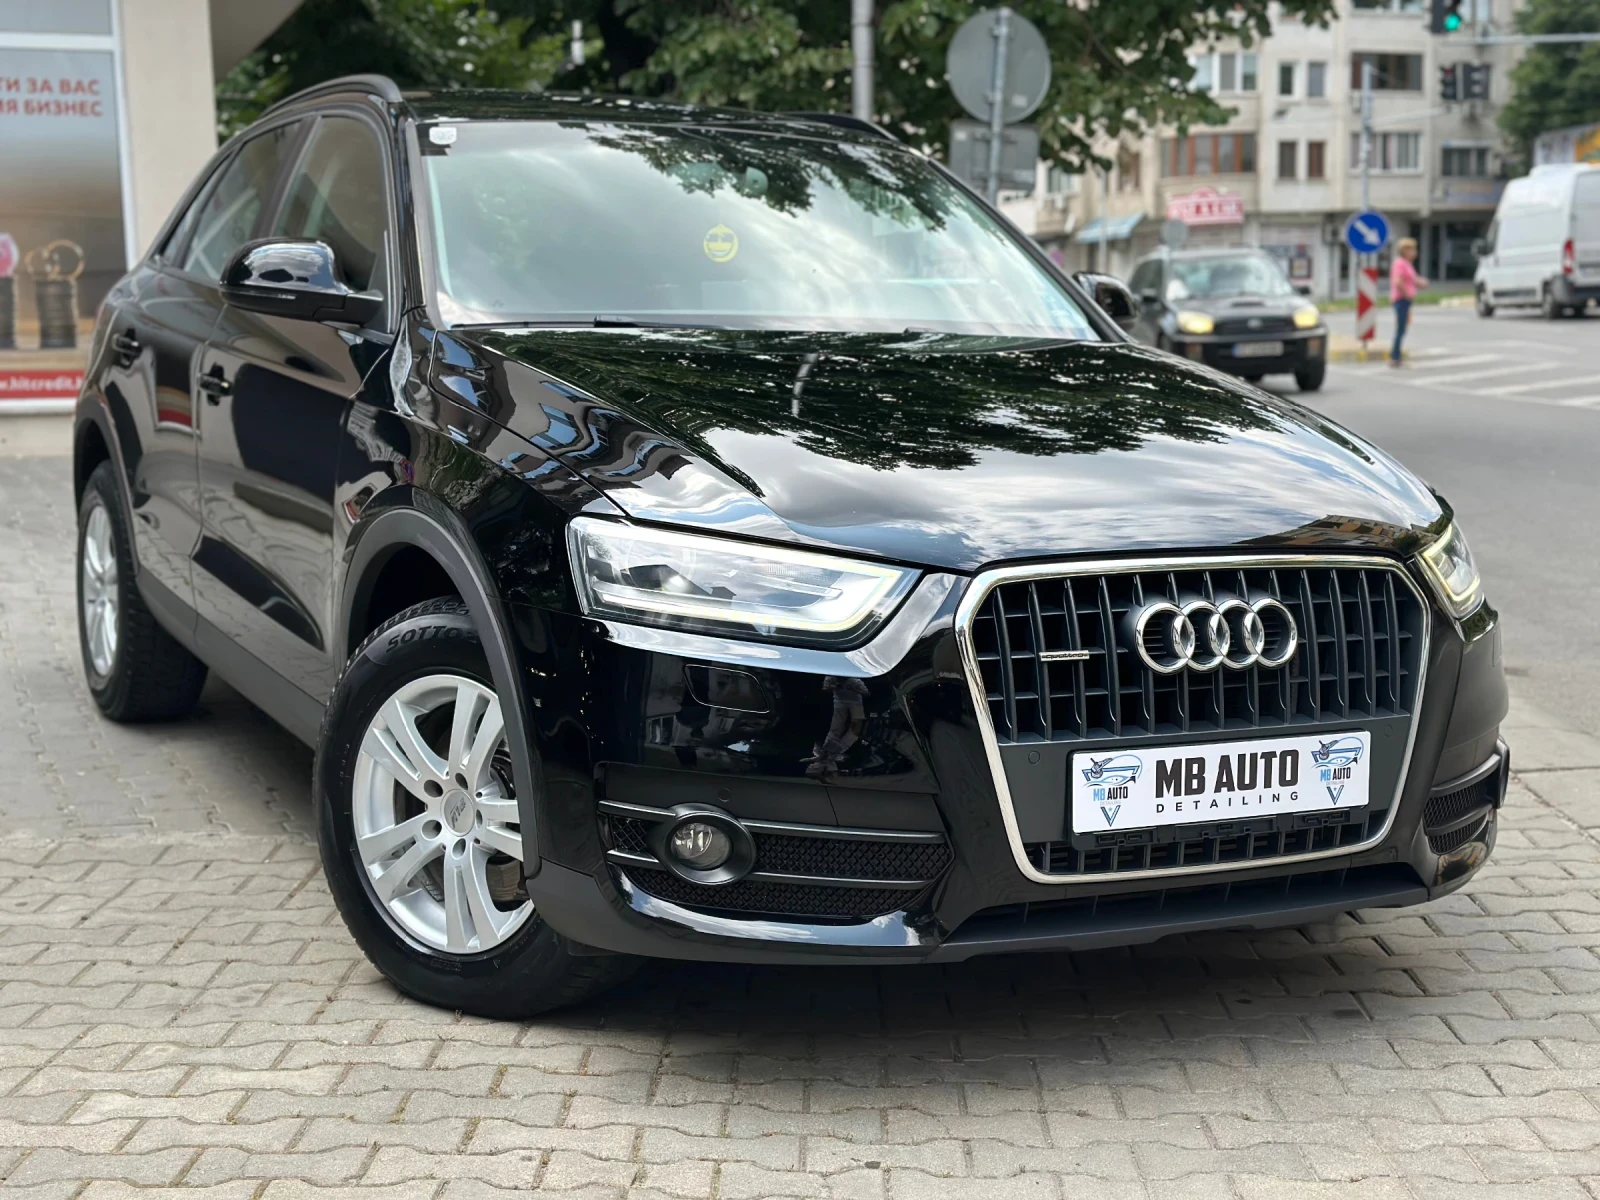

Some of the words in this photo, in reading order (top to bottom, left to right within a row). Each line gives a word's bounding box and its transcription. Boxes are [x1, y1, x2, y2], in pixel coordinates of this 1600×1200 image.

[26, 77, 53, 94] ЗА
[59, 78, 100, 96] ВАС
[23, 99, 103, 117] БИЗНЕС
[1155, 757, 1206, 798] MB
[1214, 749, 1299, 793] AUTO
[1320, 768, 1331, 781] MB
[1332, 766, 1351, 780] AUTO
[1093, 788, 1105, 801] MB
[1107, 786, 1128, 800] AUTO
[1156, 792, 1298, 813] DETAILING
